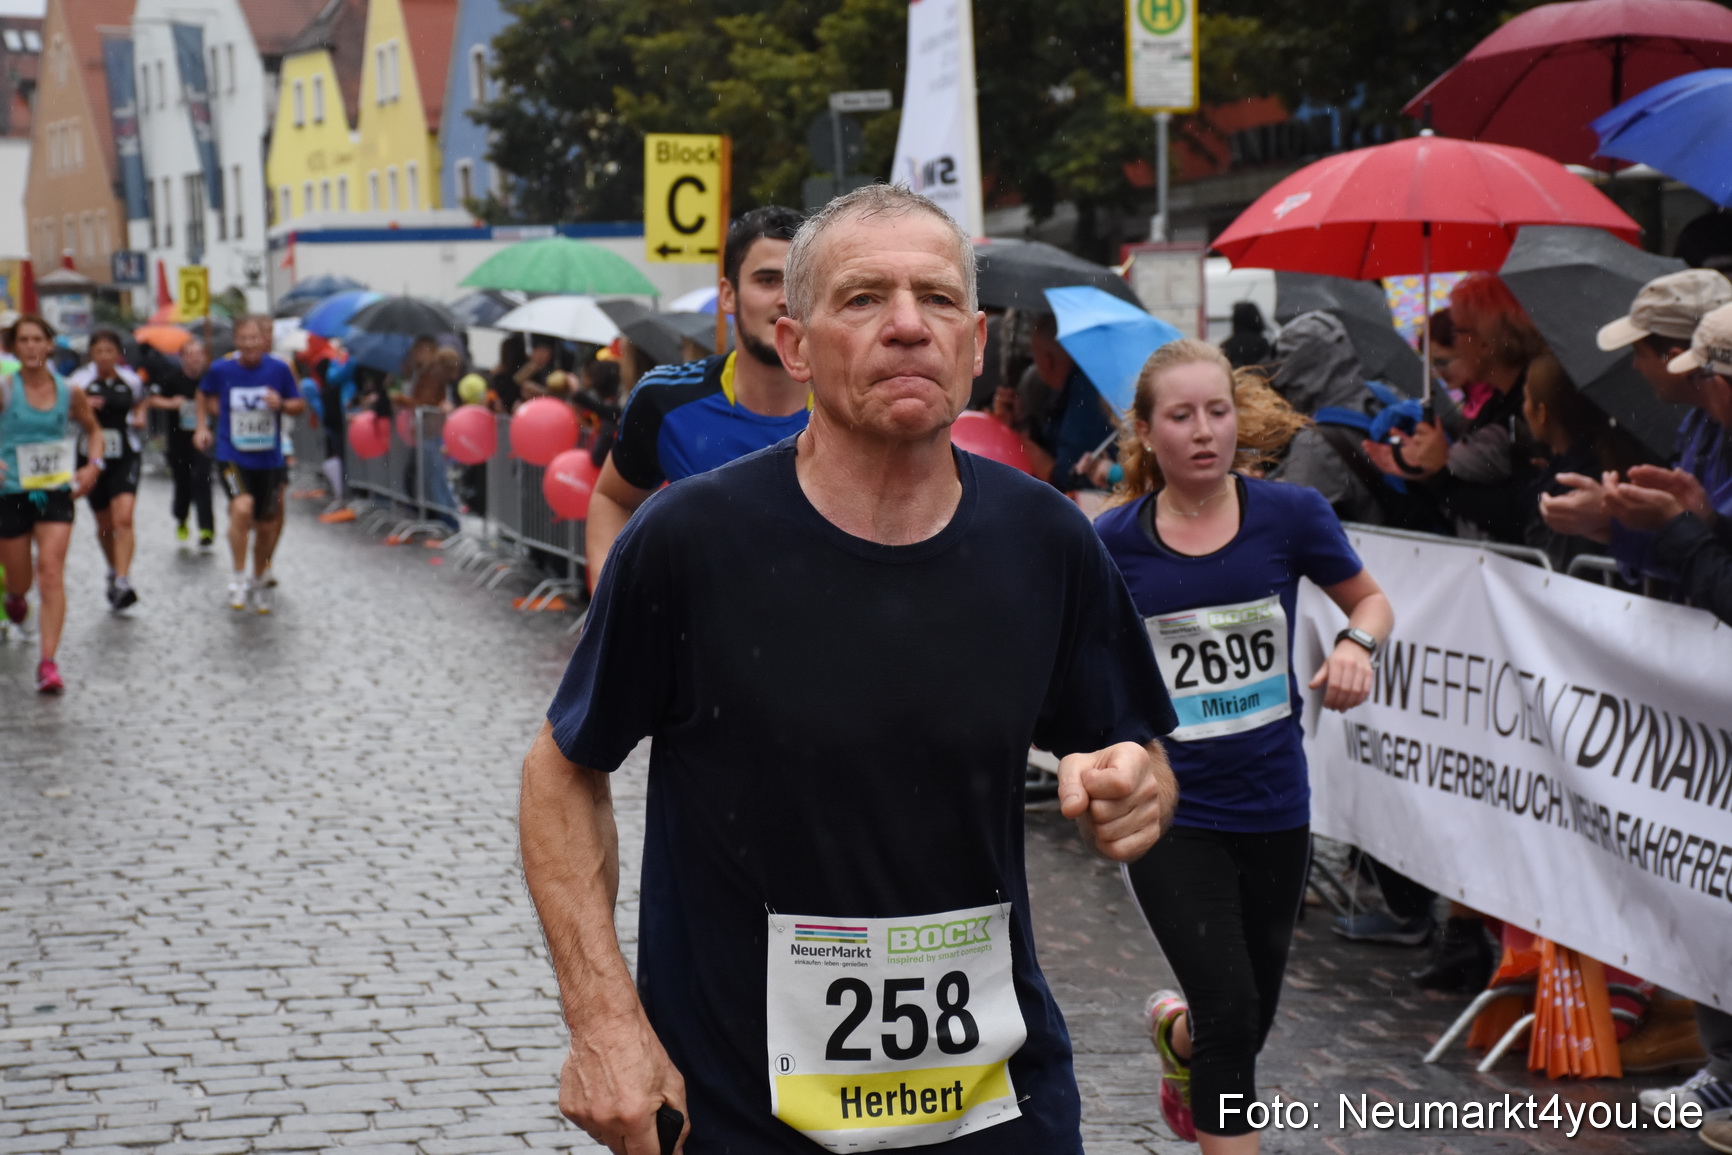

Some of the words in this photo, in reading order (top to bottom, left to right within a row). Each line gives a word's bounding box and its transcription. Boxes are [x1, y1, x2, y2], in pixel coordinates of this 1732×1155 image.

[656, 140, 720, 164] Block
[667, 175, 706, 235] C
[185, 280, 201, 306] D
[1208, 604, 1272, 630] BOCK
[1171, 629, 1275, 690] 2696
[1202, 693, 1260, 718] Miriam
[1344, 719, 1422, 784] WENIGER
[1427, 743, 1569, 830] VERBRAUCH.
[888, 916, 992, 954] BOCK
[791, 944, 872, 959] NeuerMarkt
[887, 955, 924, 965] inspired
[927, 954, 936, 963] by
[938, 950, 960, 960] smart
[960, 944, 993, 957] concepts
[825, 970, 980, 1061] 258
[780, 1057, 790, 1071] D
[841, 1080, 963, 1119] Herbert
